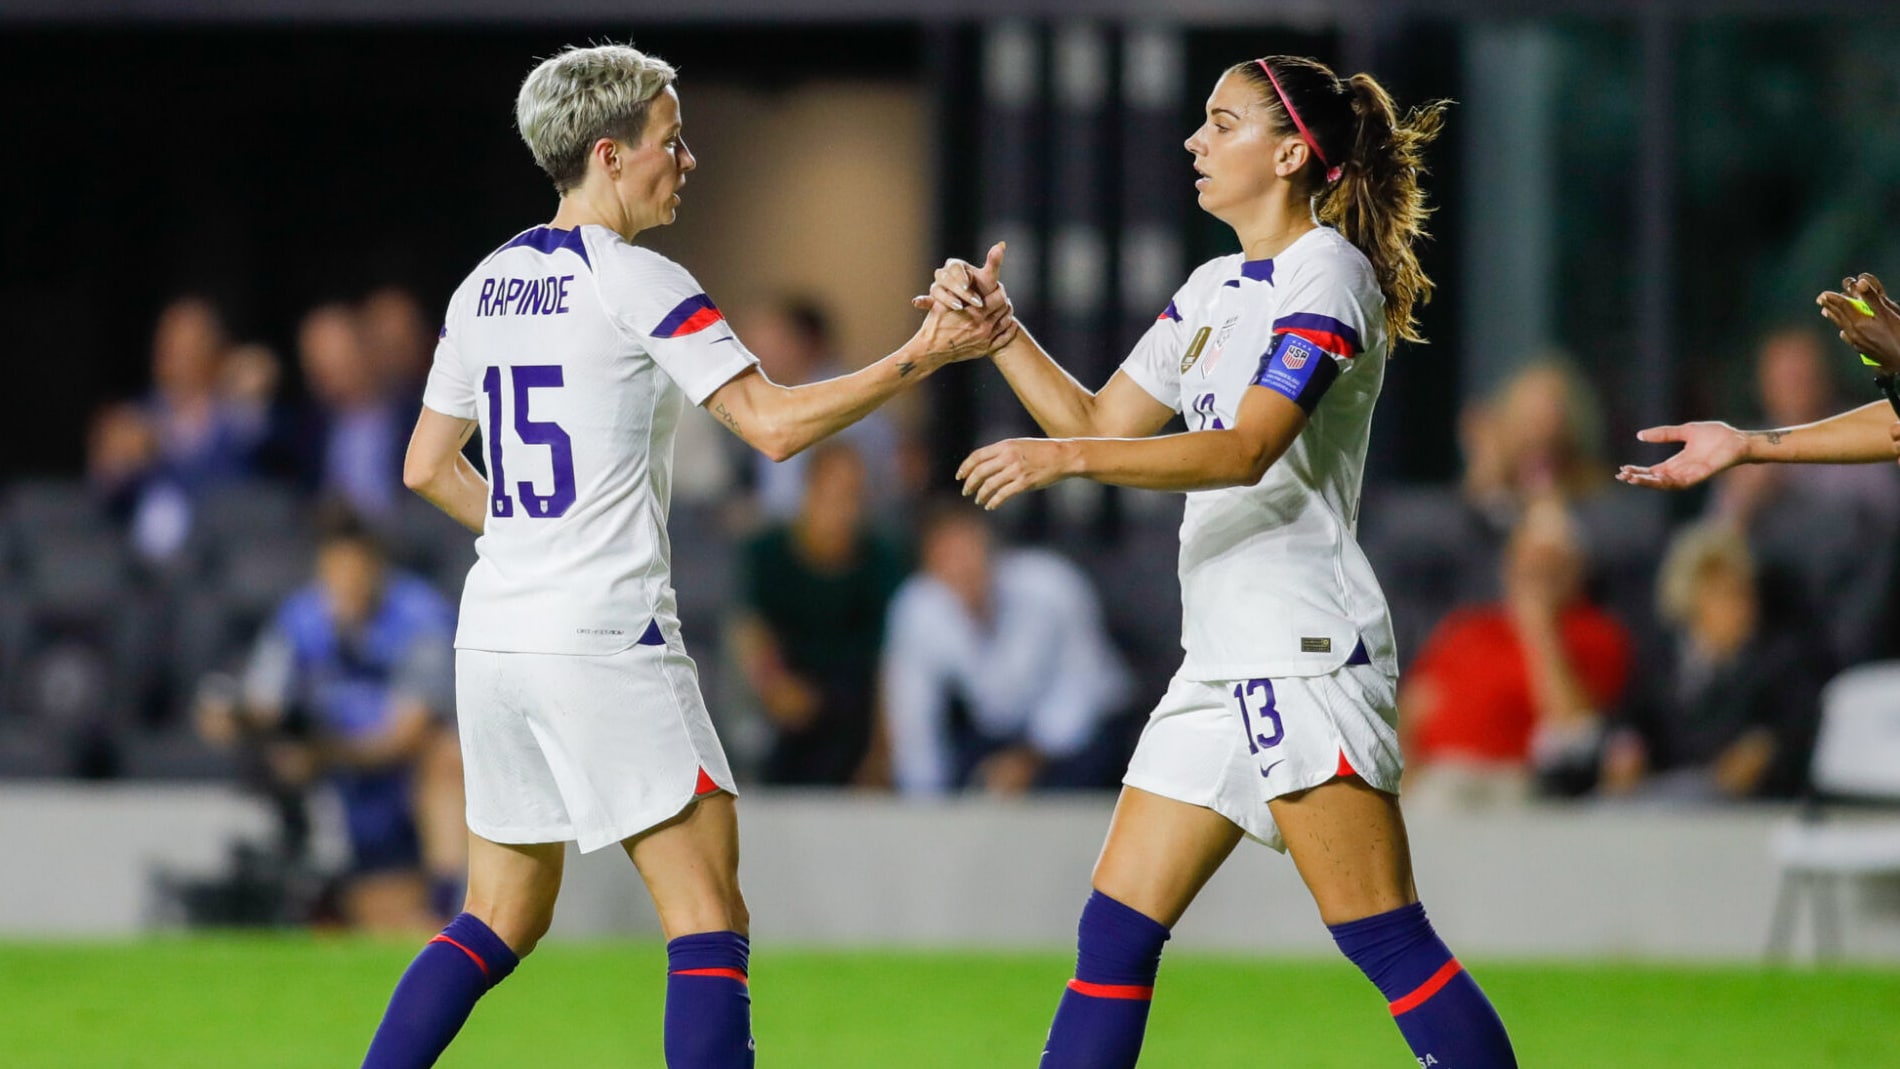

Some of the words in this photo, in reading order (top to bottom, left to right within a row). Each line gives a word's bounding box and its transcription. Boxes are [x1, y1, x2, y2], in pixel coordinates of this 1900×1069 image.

[477, 275, 574, 317] RAPINOE
[1288, 346, 1308, 360] USA
[483, 365, 576, 518] 15
[1233, 678, 1285, 755] 13
